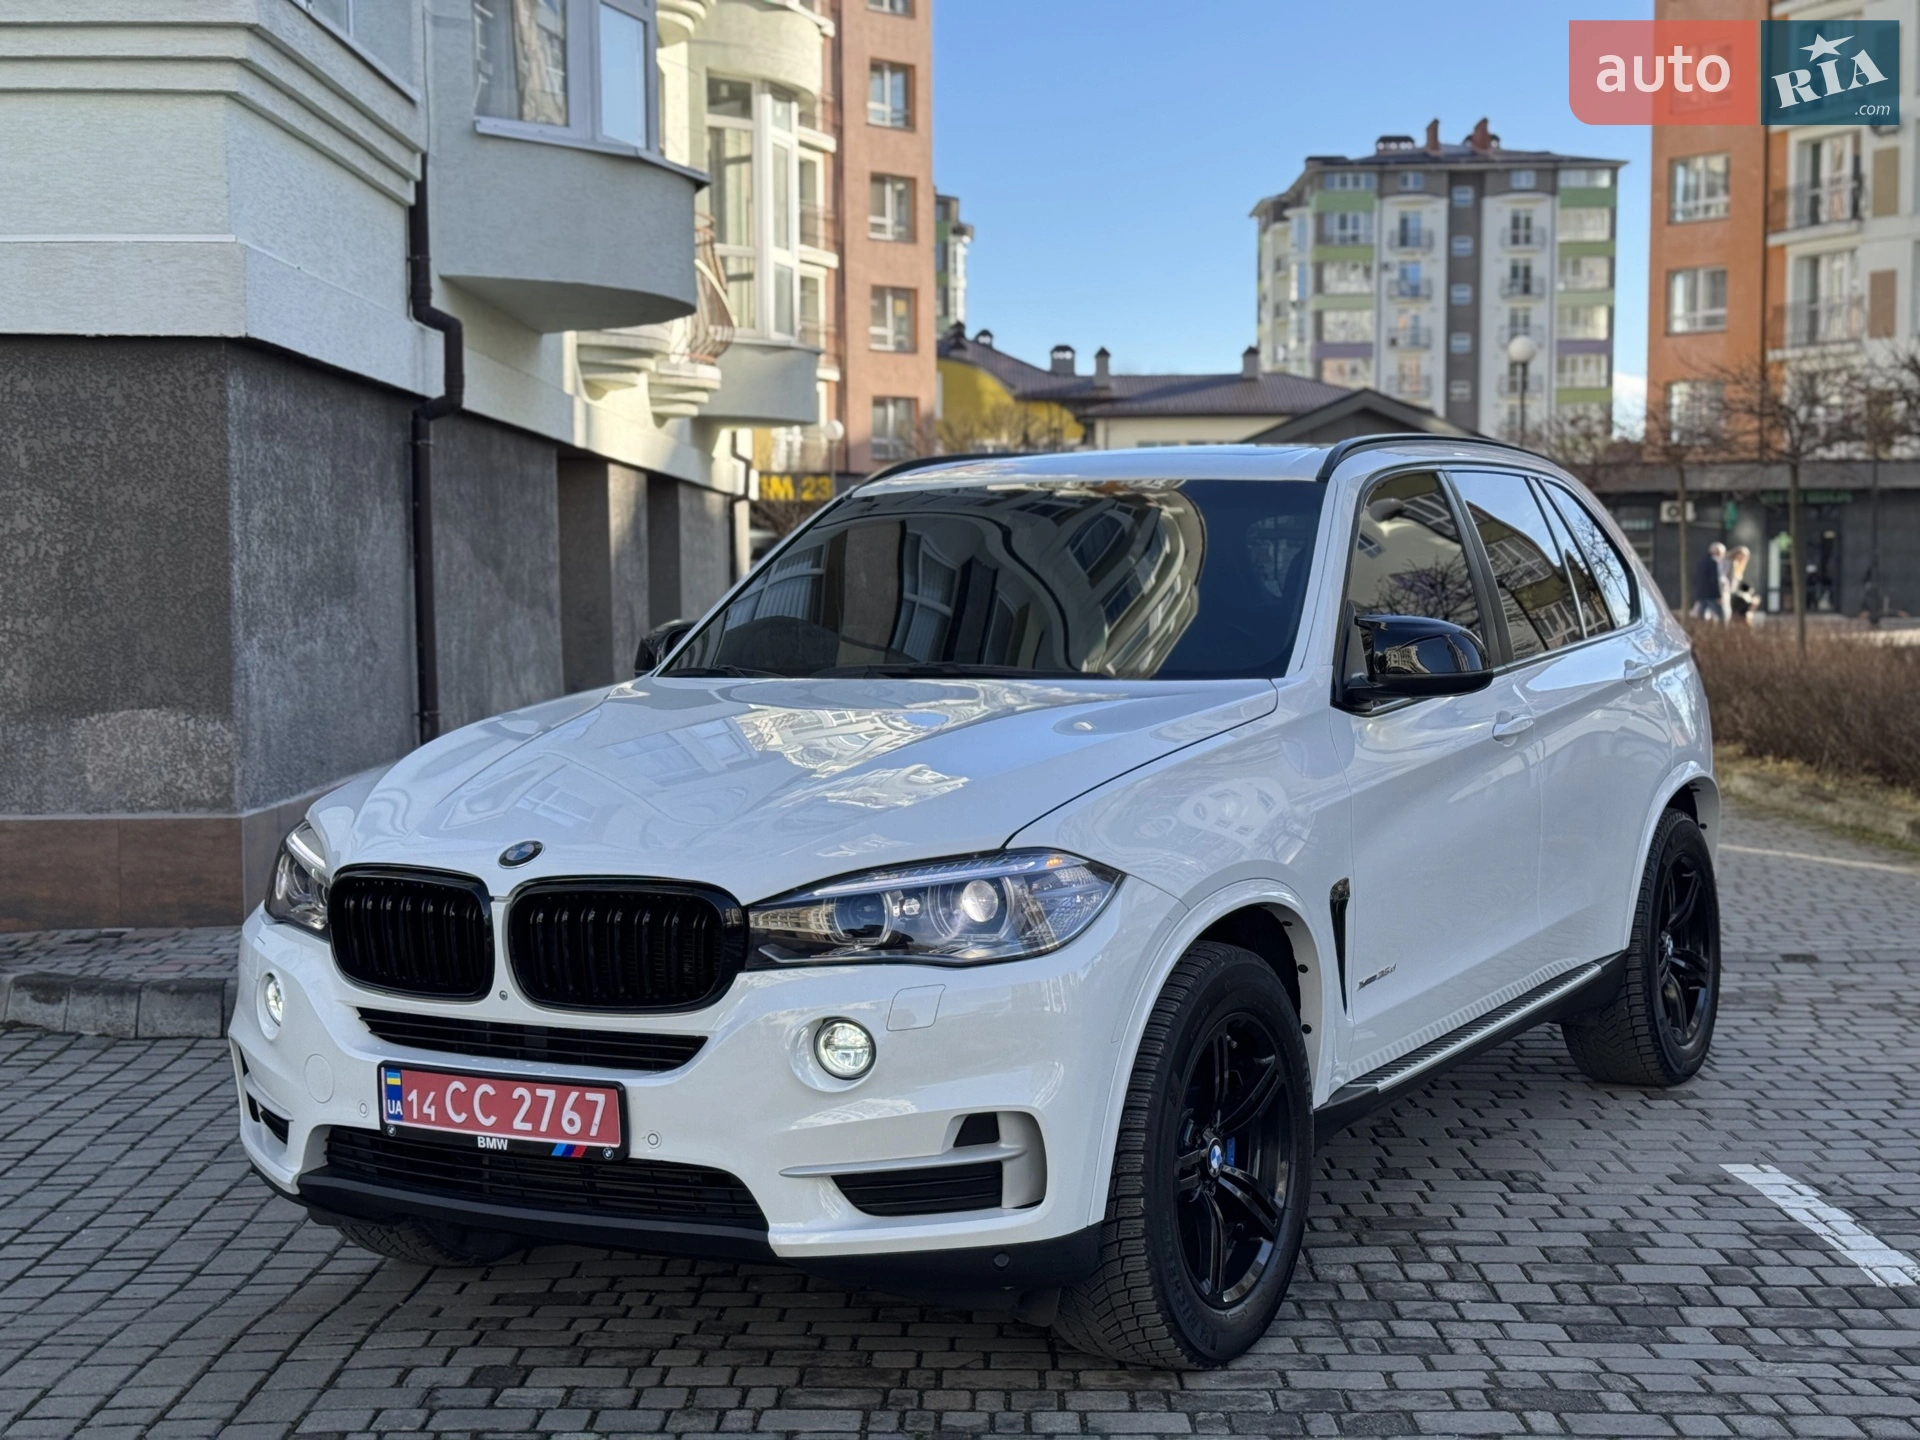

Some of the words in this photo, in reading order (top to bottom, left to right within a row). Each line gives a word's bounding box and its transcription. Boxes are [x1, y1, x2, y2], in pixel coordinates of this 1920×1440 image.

[387, 1099, 404, 1116] UA
[407, 1089, 436, 1122] 14
[445, 1080, 498, 1127] CC
[512, 1087, 606, 1137] 2767
[477, 1136, 508, 1151] BMW
